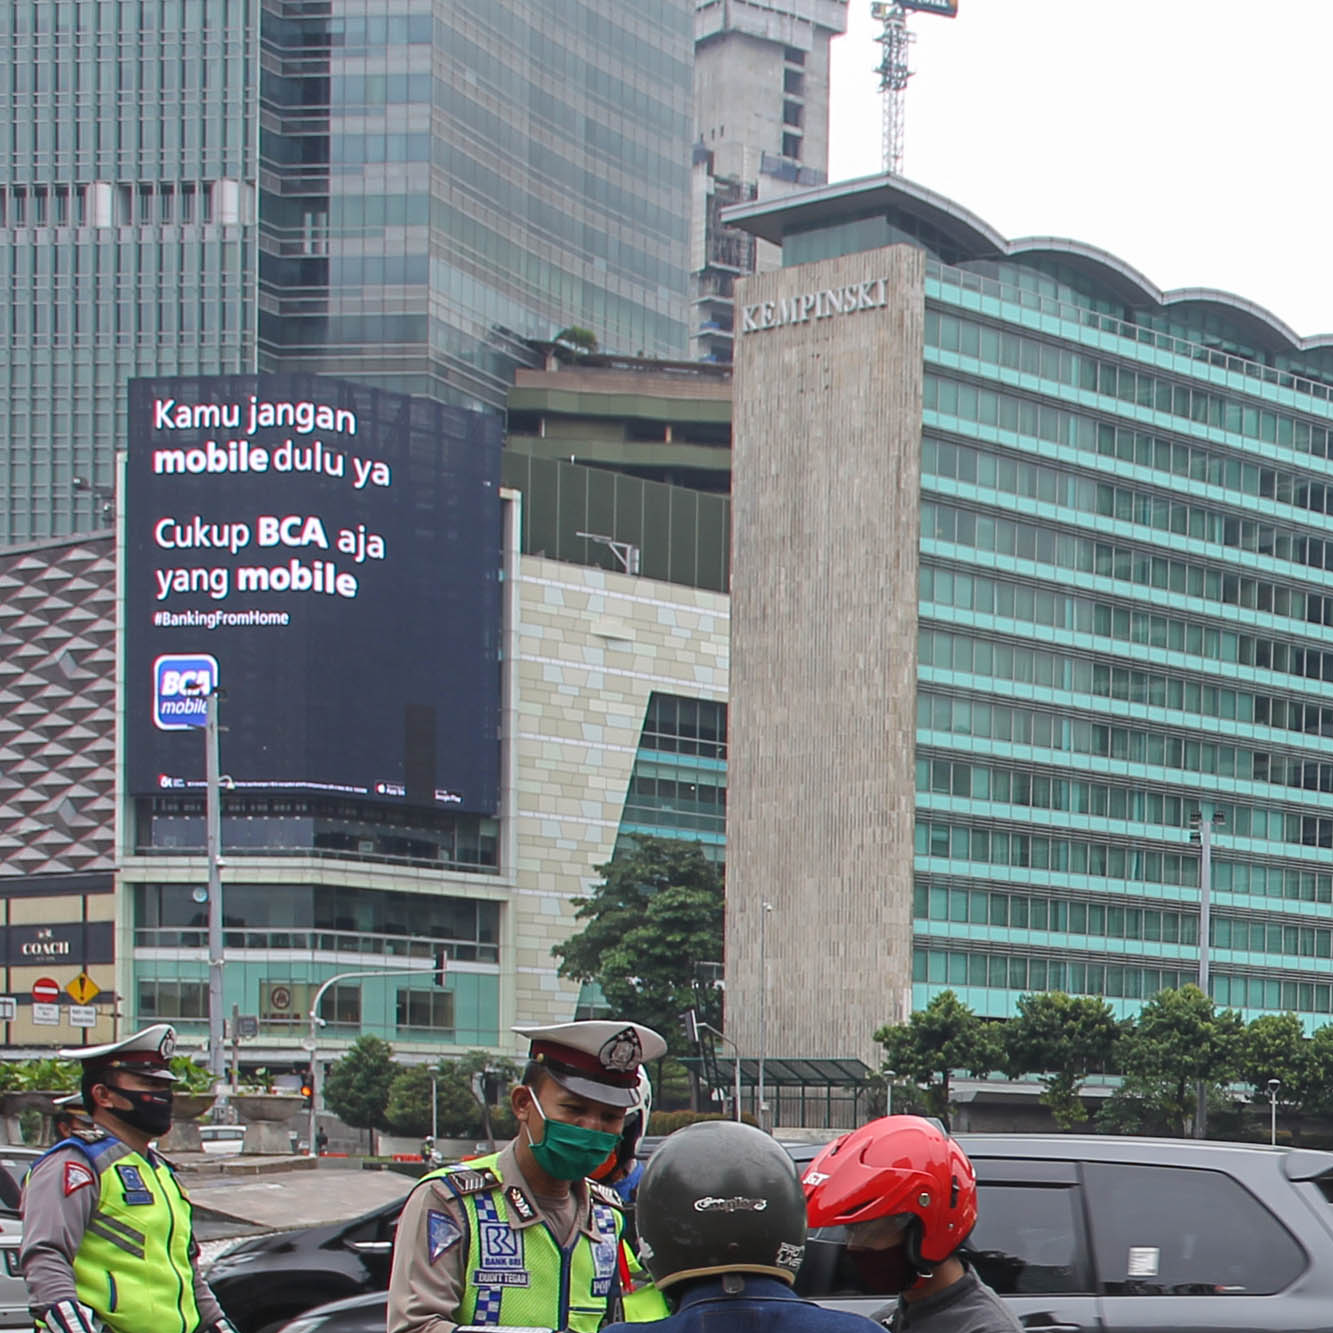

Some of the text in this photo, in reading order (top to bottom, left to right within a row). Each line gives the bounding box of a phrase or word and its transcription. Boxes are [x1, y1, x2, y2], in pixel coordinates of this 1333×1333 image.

[743, 278, 888, 333] KEMPINSKI
[155, 396, 356, 434] Kamu jangan
[154, 440, 391, 488] mobile dulu ya
[155, 516, 385, 563] Cukup BCA aja
[156, 559, 358, 600] yang mobile
[154, 610, 289, 629] #BankingFromHome
[161, 670, 211, 696] BCA
[22, 941, 69, 955] COACH
